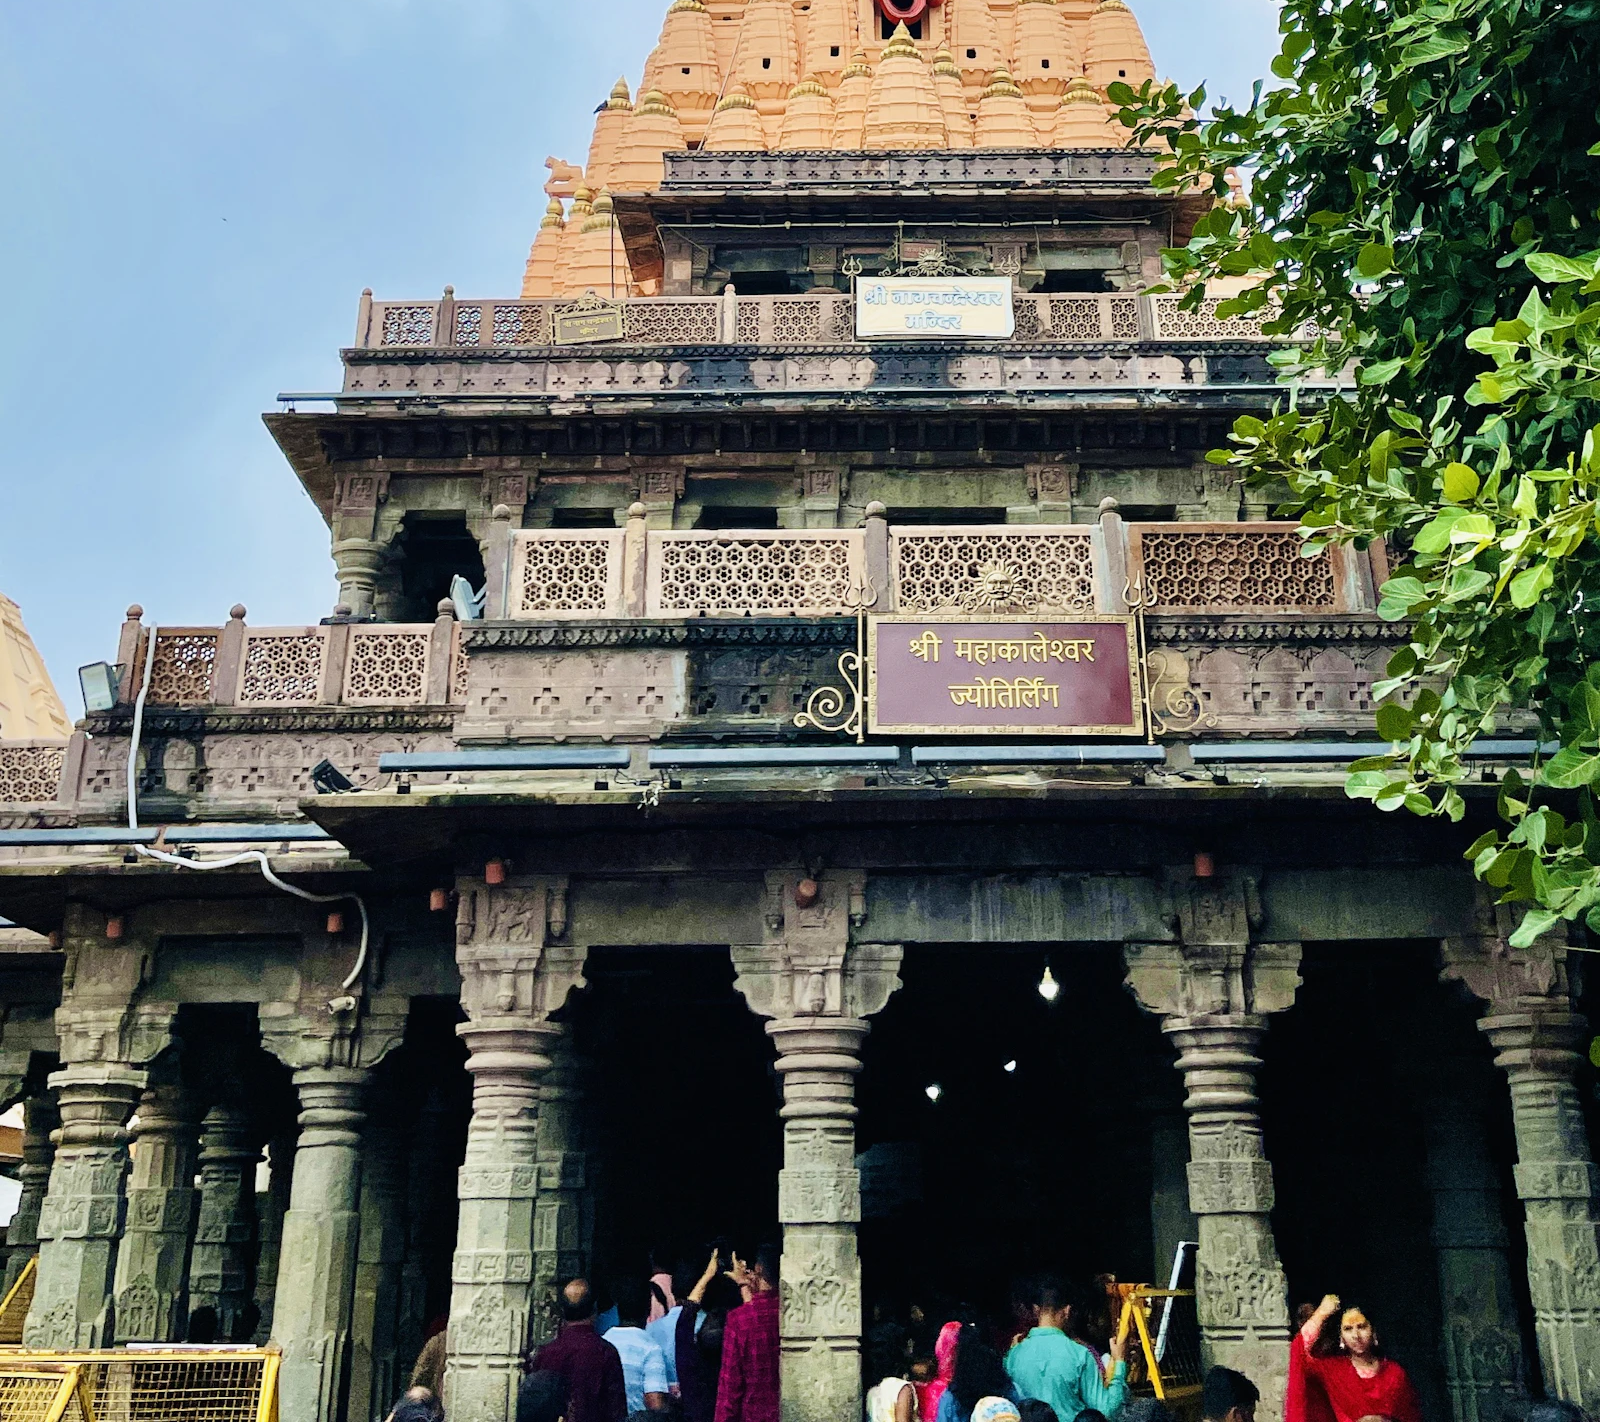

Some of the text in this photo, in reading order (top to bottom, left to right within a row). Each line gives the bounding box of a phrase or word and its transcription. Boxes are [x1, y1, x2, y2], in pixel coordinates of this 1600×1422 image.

[864, 284, 888, 306] श्री
[905, 308, 963, 330] मन्दिर
[908, 630, 1096, 666] श्री महाकालेश्वर
[948, 676, 1060, 709] ज्योतिर्लिंग
